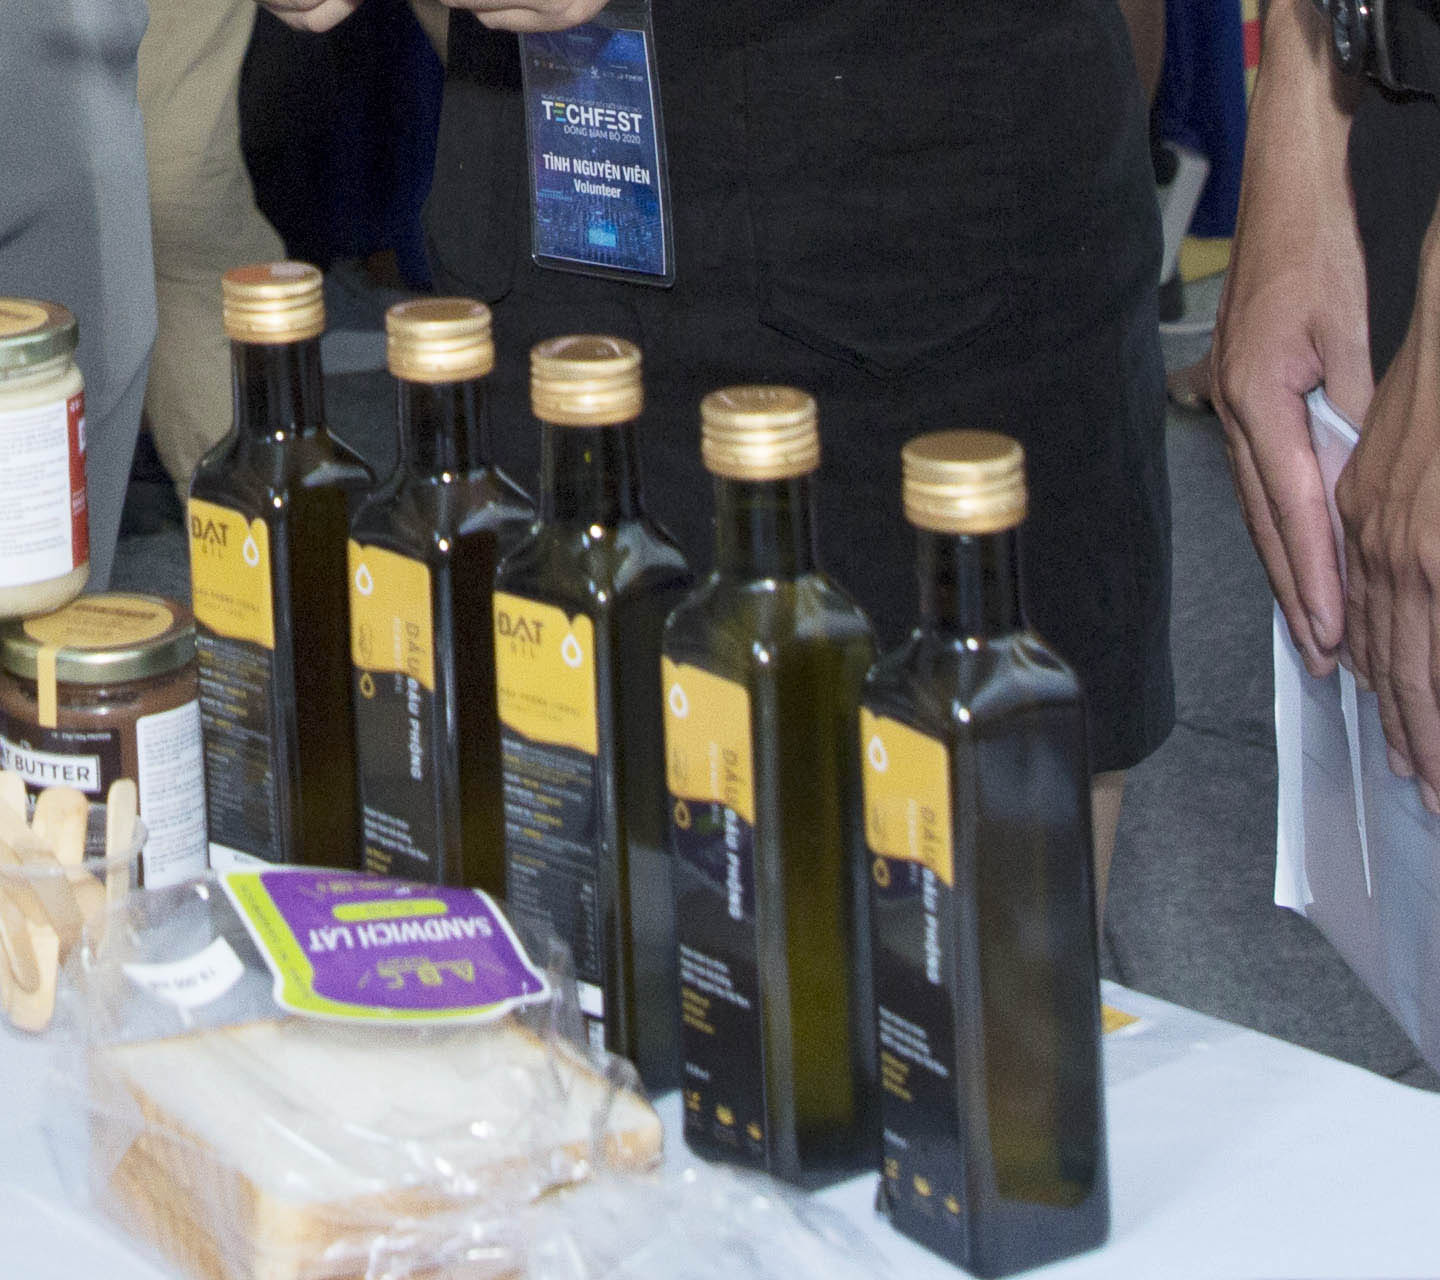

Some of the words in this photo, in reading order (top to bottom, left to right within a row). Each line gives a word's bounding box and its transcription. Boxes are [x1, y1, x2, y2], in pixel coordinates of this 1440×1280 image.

[541, 100, 642, 133] TECHFEST
[622, 133, 641, 145] 2020
[543, 152, 570, 173] TÌNH
[573, 157, 621, 181] NGUYỆN
[622, 162, 650, 185] VIÊN
[573, 178, 622, 199] Volunteer
[14, 754, 91, 782] BUTTER
[358, 916, 494, 949] SANDWICH
